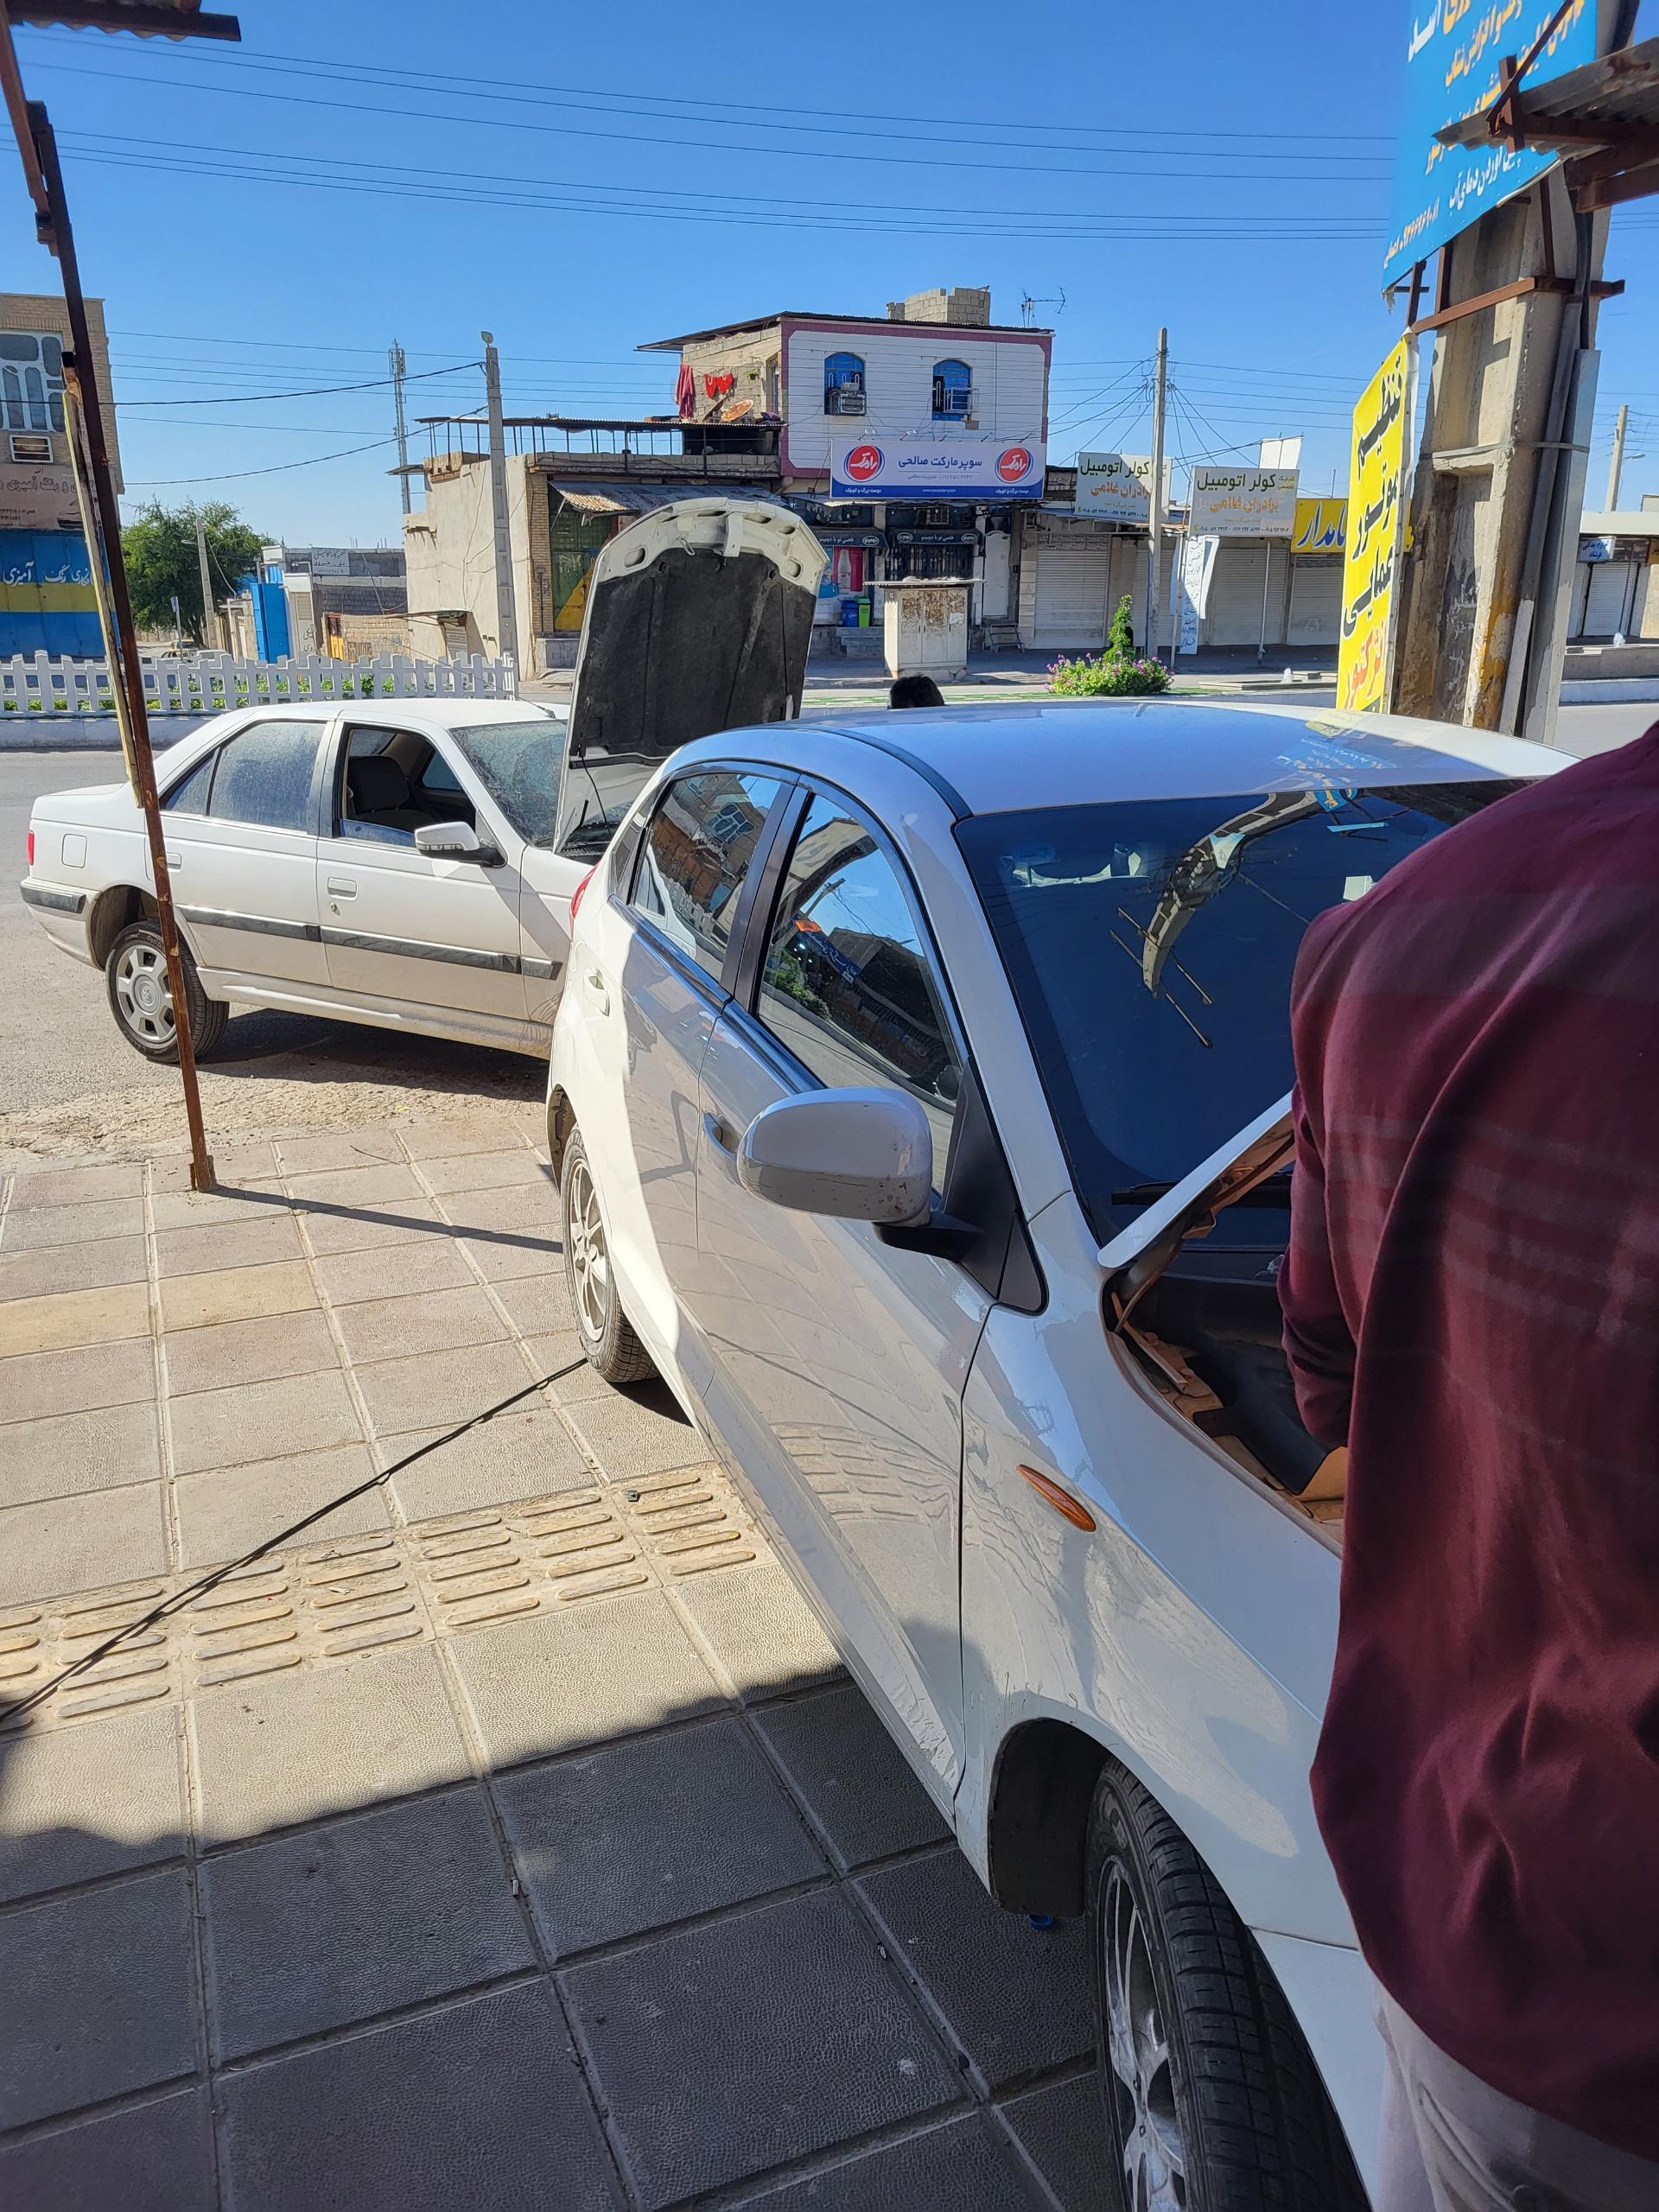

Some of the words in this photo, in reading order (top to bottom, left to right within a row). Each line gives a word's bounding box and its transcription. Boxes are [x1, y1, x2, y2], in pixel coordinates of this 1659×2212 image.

[1357, 355, 1402, 484] تنظیم
[899, 455, 929, 468] صالحی
[1080, 458, 1122, 477] اتومبیل
[1124, 461, 1150, 479] کولر
[7, 475, 38, 493] آمیزی
[1091, 480, 1118, 497] غلامی
[1197, 472, 1246, 491] اتومبیل
[1249, 474, 1276, 492] کولر
[1209, 496, 1243, 513] غلامی
[1243, 497, 1279, 513] برادران
[1351, 461, 1400, 561] موتور
[3, 560, 35, 588] آمیزی
[45, 563, 69, 583] رنگ
